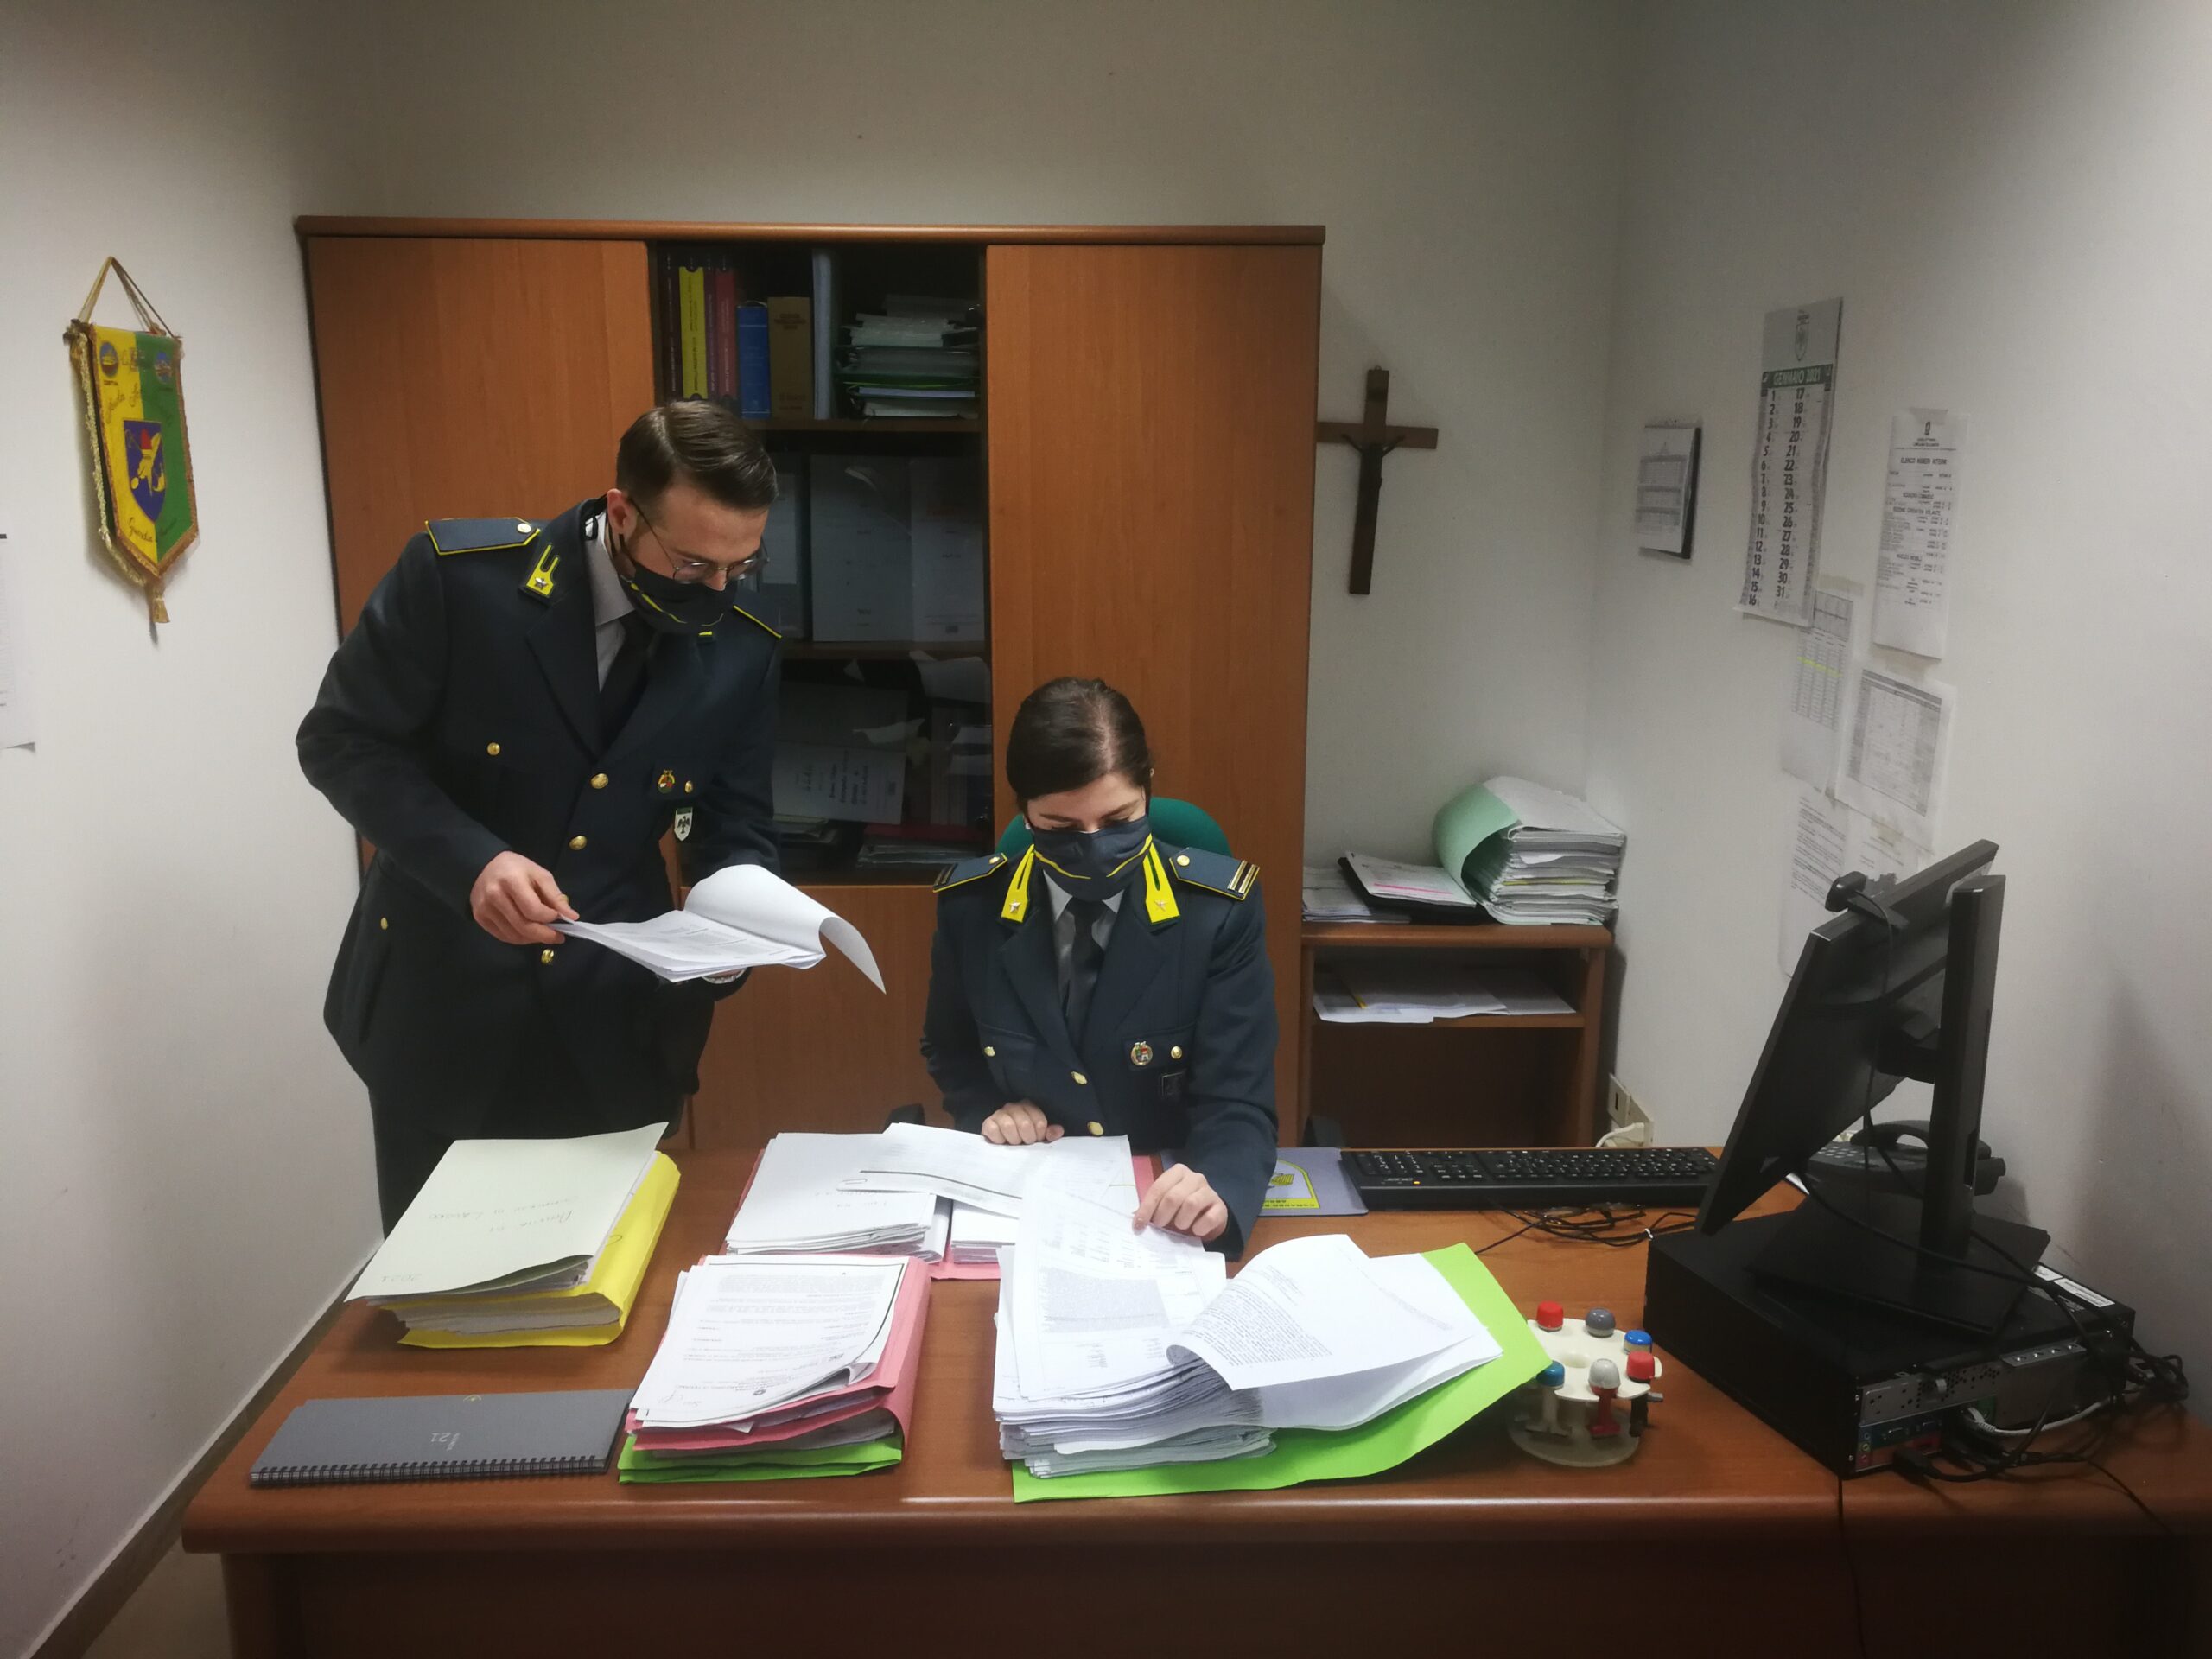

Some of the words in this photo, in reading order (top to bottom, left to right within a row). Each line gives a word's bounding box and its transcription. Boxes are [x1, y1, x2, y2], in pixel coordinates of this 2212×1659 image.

[1773, 371, 1804, 385] GENNAIO
[1806, 367, 1821, 383] 2021
[1771, 390, 1776, 401] 1
[1796, 387, 1804, 399] 17
[1770, 403, 1775, 415] 2
[1794, 402, 1804, 414] 18
[1768, 417, 1773, 429] 3
[1793, 416, 1802, 428] 19
[1766, 431, 1771, 442] 4
[1789, 430, 1800, 442] 20
[1763, 445, 1770, 456] 5
[1786, 444, 1796, 456] 21
[1761, 460, 1766, 471] 6
[1784, 460, 1795, 471] 22
[1761, 473, 1766, 484] 7
[1783, 474, 1793, 486] 23
[1761, 486, 1766, 498] 8
[1784, 487, 1795, 499] 24
[1761, 499, 1766, 512] 9
[1784, 501, 1794, 513] 25
[1758, 513, 1765, 525] 10
[1783, 516, 1793, 528] 26
[1757, 527, 1764, 538] 11
[1782, 530, 1791, 542] 27
[1755, 541, 1763, 552] 12
[1780, 543, 1791, 556] 28
[1754, 553, 1762, 565] 13
[1779, 557, 1789, 570] 29
[1752, 567, 1760, 579] 14
[1777, 571, 1788, 584] 30
[1751, 581, 1759, 593] 15
[1776, 585, 1785, 598] 31
[1749, 594, 1757, 606] 16
